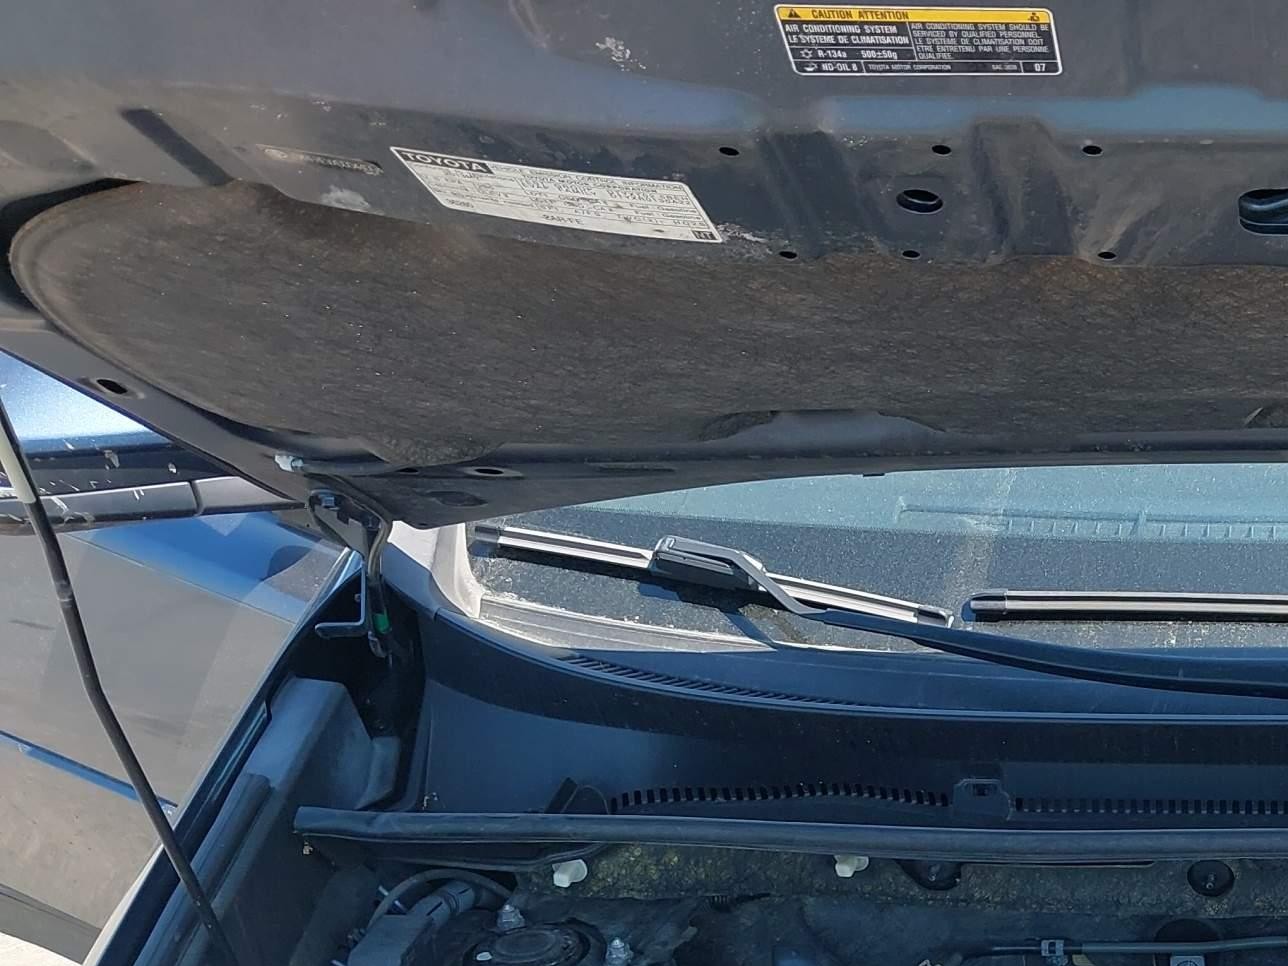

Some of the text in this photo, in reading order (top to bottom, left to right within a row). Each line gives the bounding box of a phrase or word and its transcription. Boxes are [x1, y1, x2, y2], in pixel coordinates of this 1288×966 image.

[811, 9, 910, 20] CAUTION ATTENTION
[785, 24, 898, 34] AIR CONDITIONING SYSTEM
[788, 35, 910, 45] LE SYSTEME DE CLIMATISATION
[973, 38, 1025, 46] CLIMATISATION
[916, 45, 933, 53] ETRE
[936, 45, 976, 53] ENTRETENU
[817, 49, 898, 60] R-134a 500±50g
[821, 63, 859, 71] ND-OIL 8
[1034, 63, 1046, 72] 07
[401, 151, 489, 173] TOYOTA
